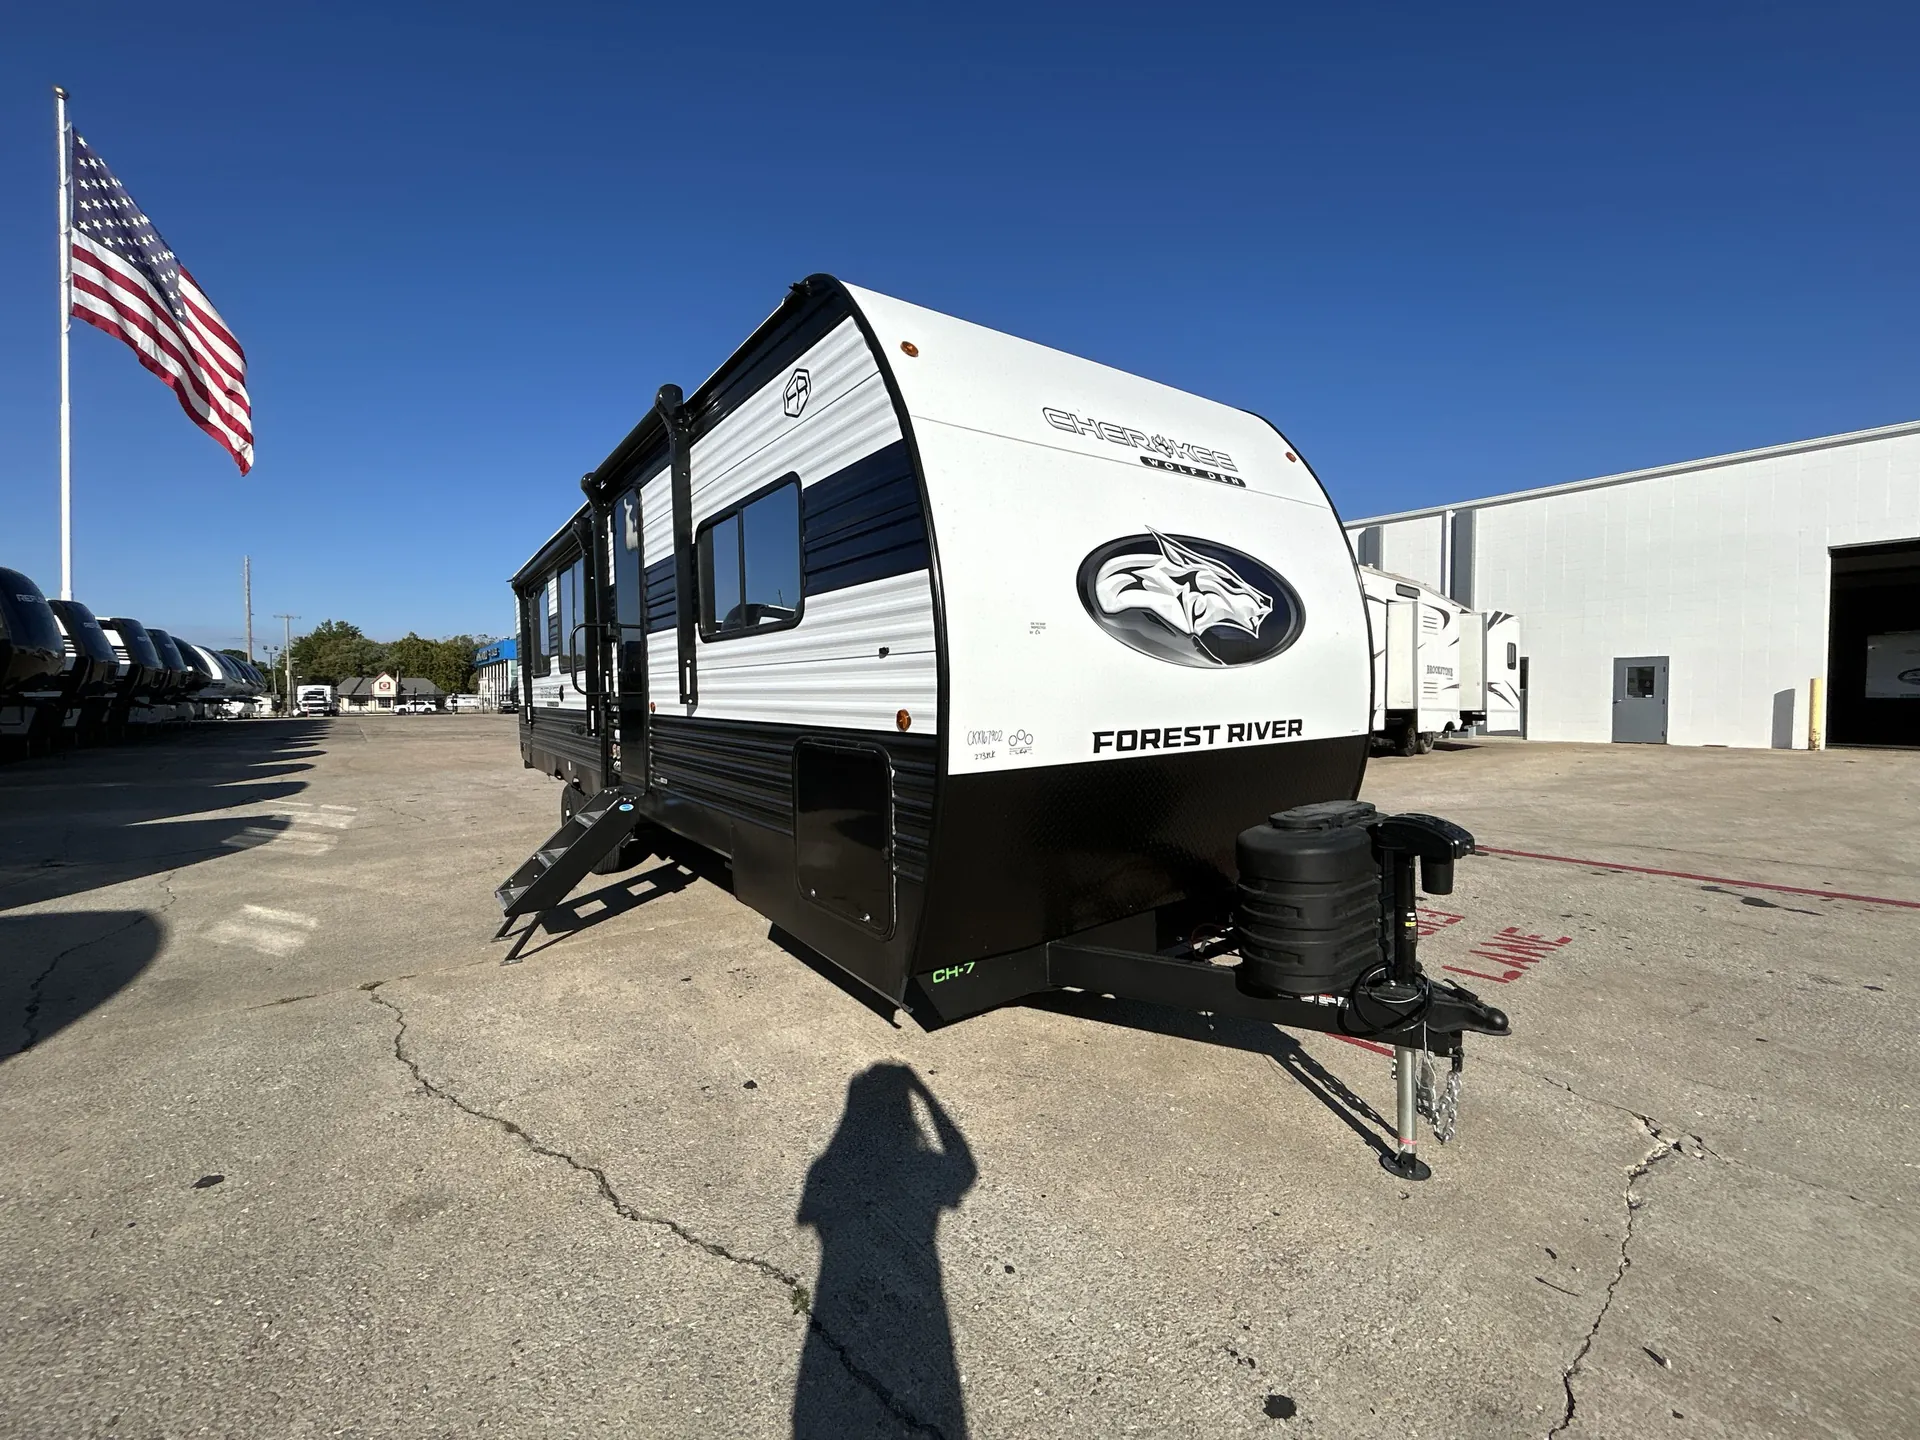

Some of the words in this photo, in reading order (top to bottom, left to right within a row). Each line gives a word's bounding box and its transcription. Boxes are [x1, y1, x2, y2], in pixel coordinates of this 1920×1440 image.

[1042, 407, 1239, 472] CHEROKEE
[1148, 457, 1198, 475] WOLF
[1207, 471, 1240, 486] DEN
[1092, 724, 1221, 753] FOREST
[1227, 718, 1303, 743] RIVER
[932, 961, 976, 983] CH-7
[1441, 926, 1573, 984] LANE
